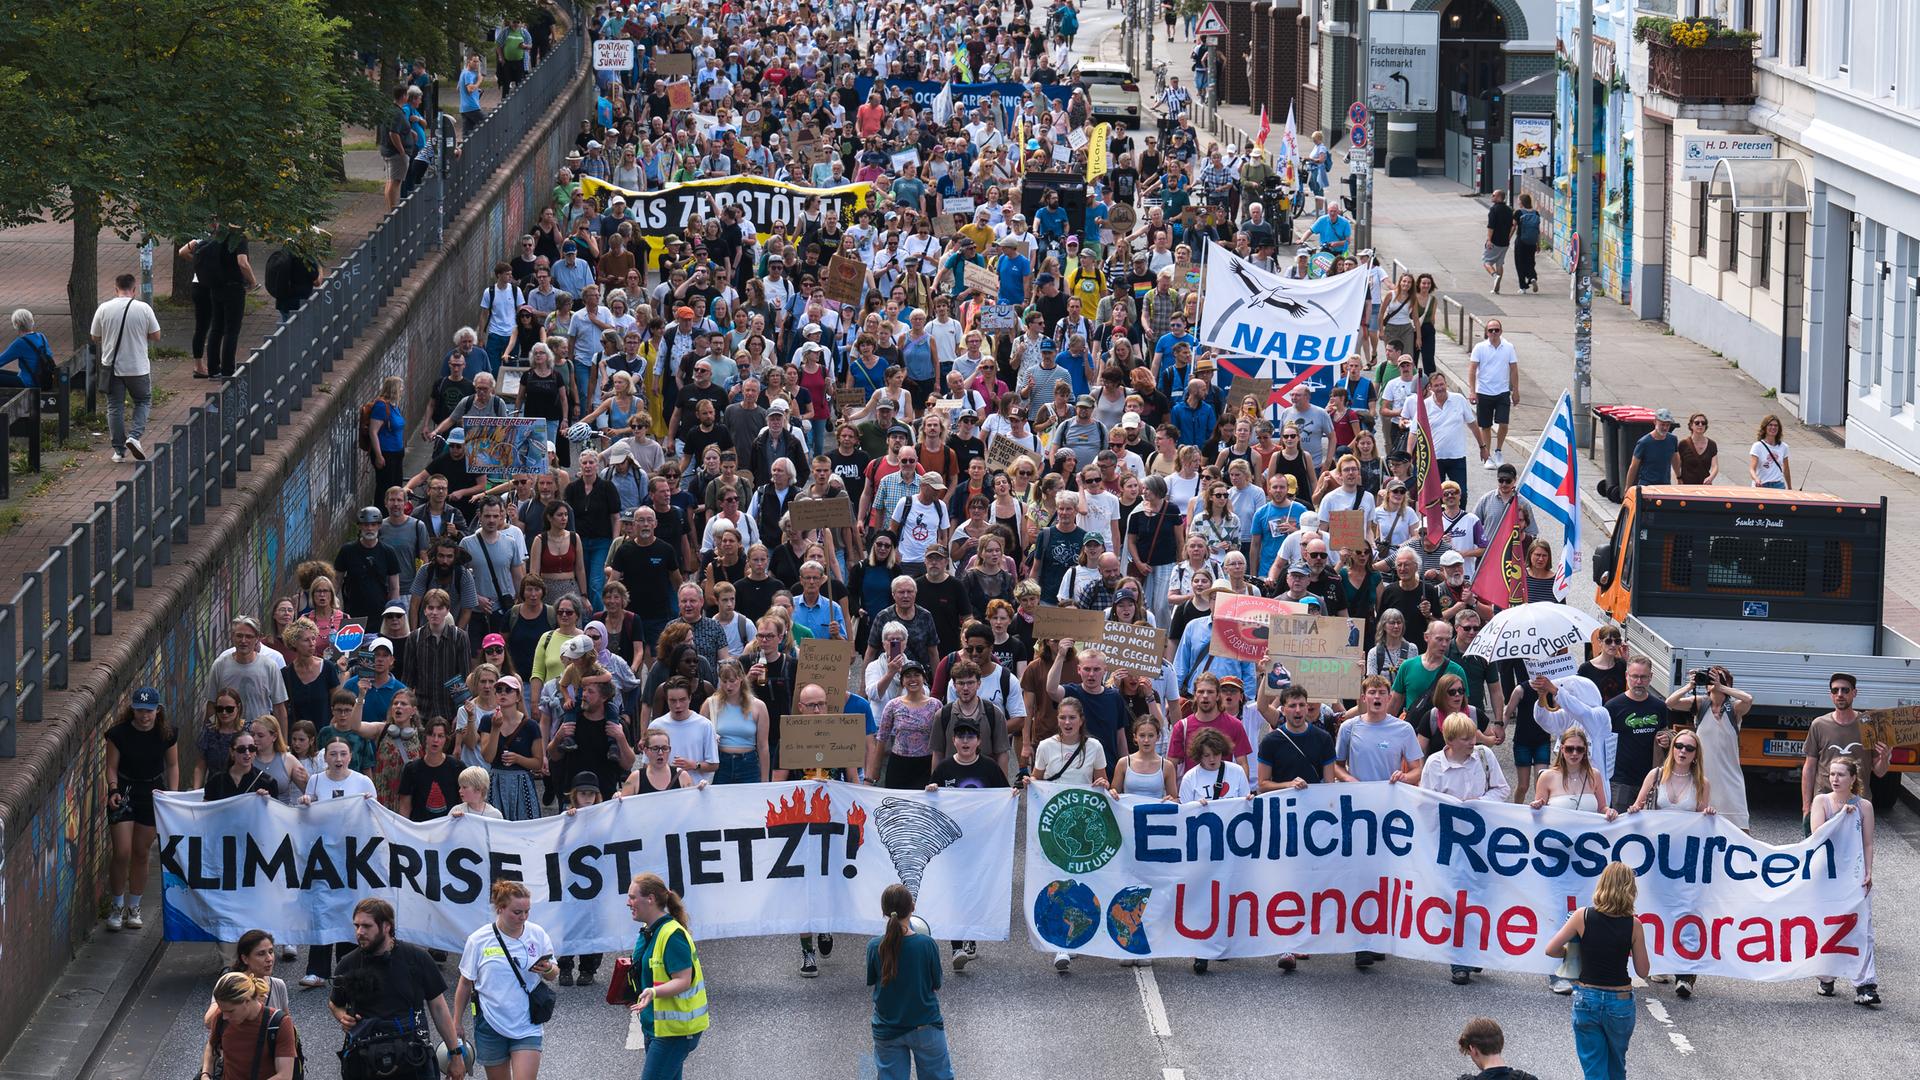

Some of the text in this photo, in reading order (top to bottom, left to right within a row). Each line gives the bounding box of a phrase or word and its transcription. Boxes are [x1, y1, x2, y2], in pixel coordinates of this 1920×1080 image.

[601, 50, 627, 59] WE WILL
[1370, 45, 1426, 56] Fischereihafen
[597, 58, 627, 67] SURVIVE
[1370, 58, 1413, 68] Fischmarkt
[1092, 127, 1104, 174] tricargo
[1705, 140, 1772, 150] H. D. Petersen
[1230, 322, 1352, 364] NABU
[466, 418, 481, 426] DIE
[994, 441, 1017, 457] THERE
[995, 435, 1029, 456] BECAUSE
[990, 446, 1010, 460] IS NO
[1735, 517, 1784, 528] Sankt Pauli
[1104, 622, 1156, 638] GRAD UND
[1273, 618, 1319, 635] KLIMA
[1501, 627, 1537, 640] on a
[339, 628, 360, 641] STOP
[1102, 633, 1155, 650] WIRD NOCH
[1496, 625, 1583, 658] dead Planet
[1122, 648, 1158, 665] GEGEN
[1537, 655, 1572, 668] ignorance
[1299, 659, 1350, 674] DADDY
[1536, 665, 1574, 676] immigrants
[785, 718, 810, 726] Kinder
[840, 717, 858, 725] Macht
[829, 742, 857, 752] Zukunft
[1770, 742, 1784, 752] HH
[1041, 793, 1107, 832] FRIDAYS FOR
[1133, 794, 1838, 888] Endliche Ressourcen
[156, 822, 861, 904] KLIMAKRISE IST JETZT!
[1068, 845, 1116, 873] FUTURE
[1174, 876, 1860, 963] Unendliche noranz
